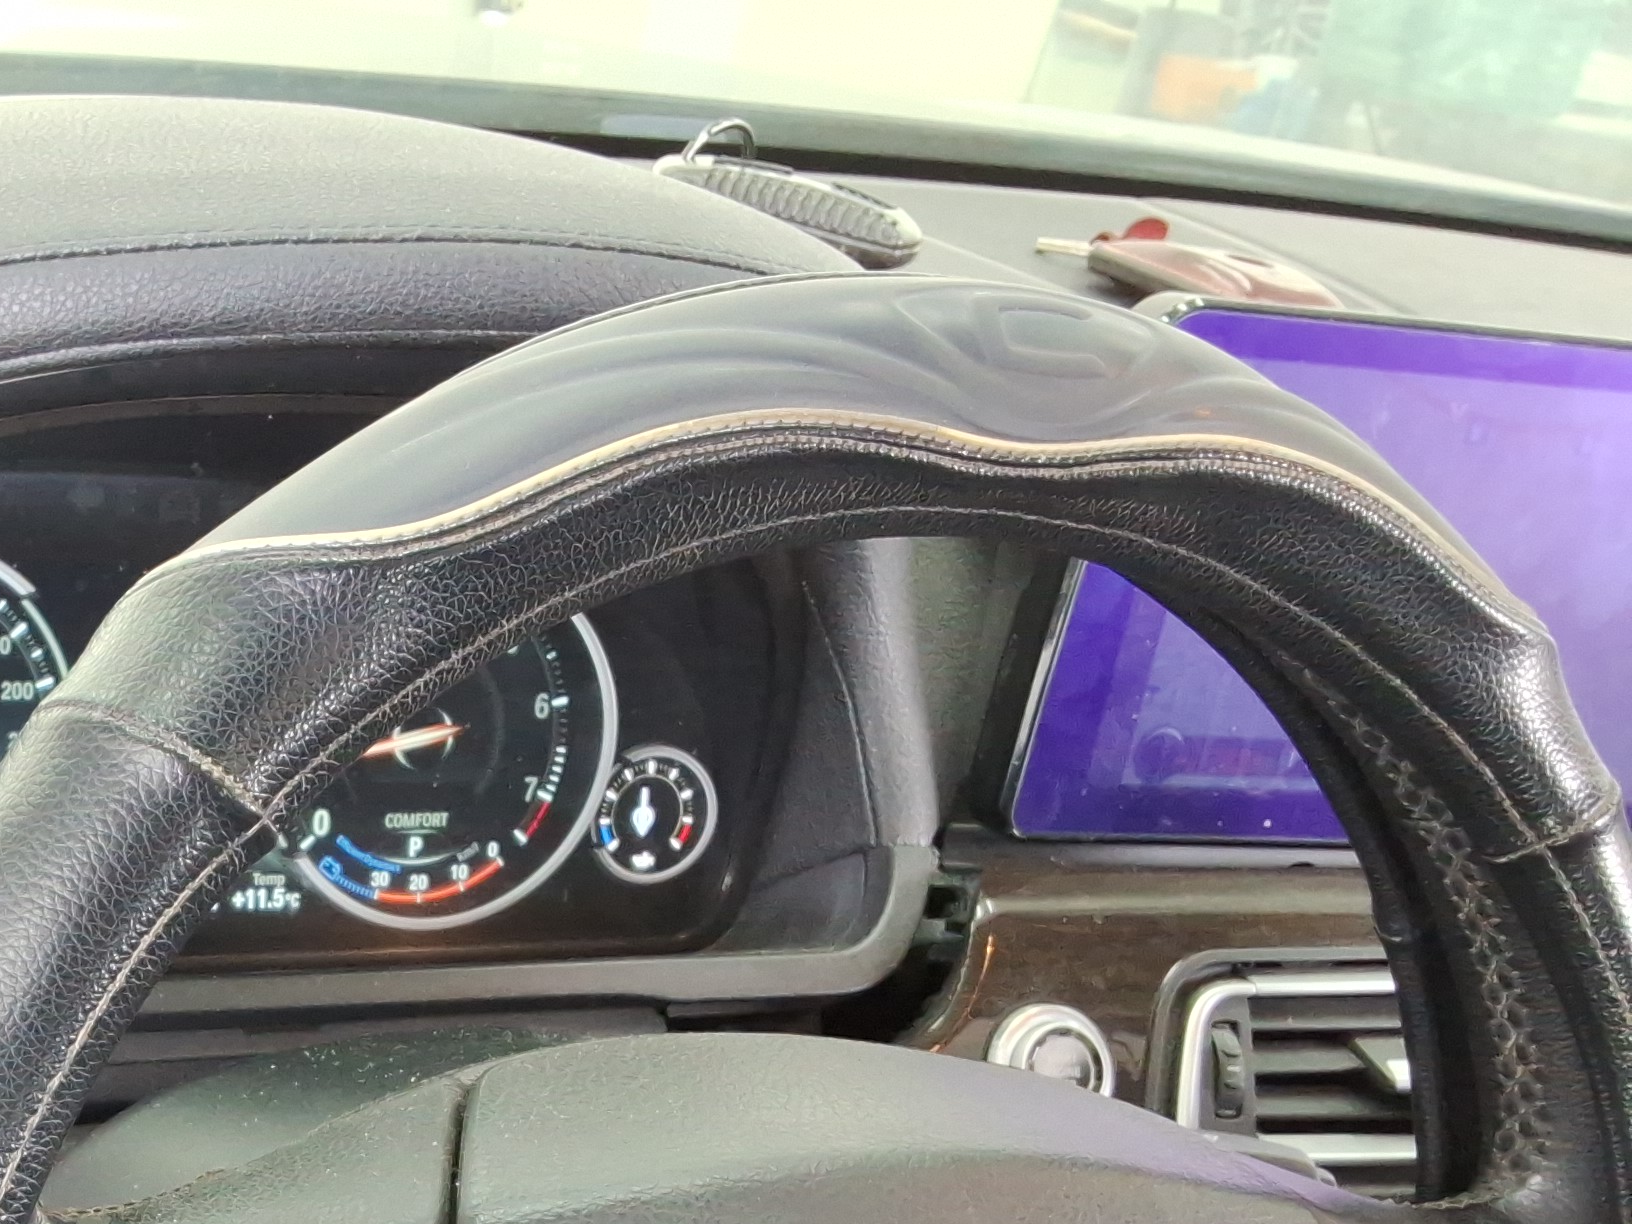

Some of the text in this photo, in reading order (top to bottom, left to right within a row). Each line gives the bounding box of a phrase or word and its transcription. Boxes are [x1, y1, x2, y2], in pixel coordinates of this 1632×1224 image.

[1, 681, 35, 701] 200
[534, 693, 550, 719] 6
[524, 776, 539, 802] 7
[312, 808, 331, 836] 0
[384, 812, 450, 829] COMFORT
[408, 836, 424, 857] P
[487, 842, 499, 857] 0
[253, 872, 286, 887] Temp
[370, 872, 389, 887] 30
[450, 865, 468, 879] 10
[409, 875, 428, 890] 20
